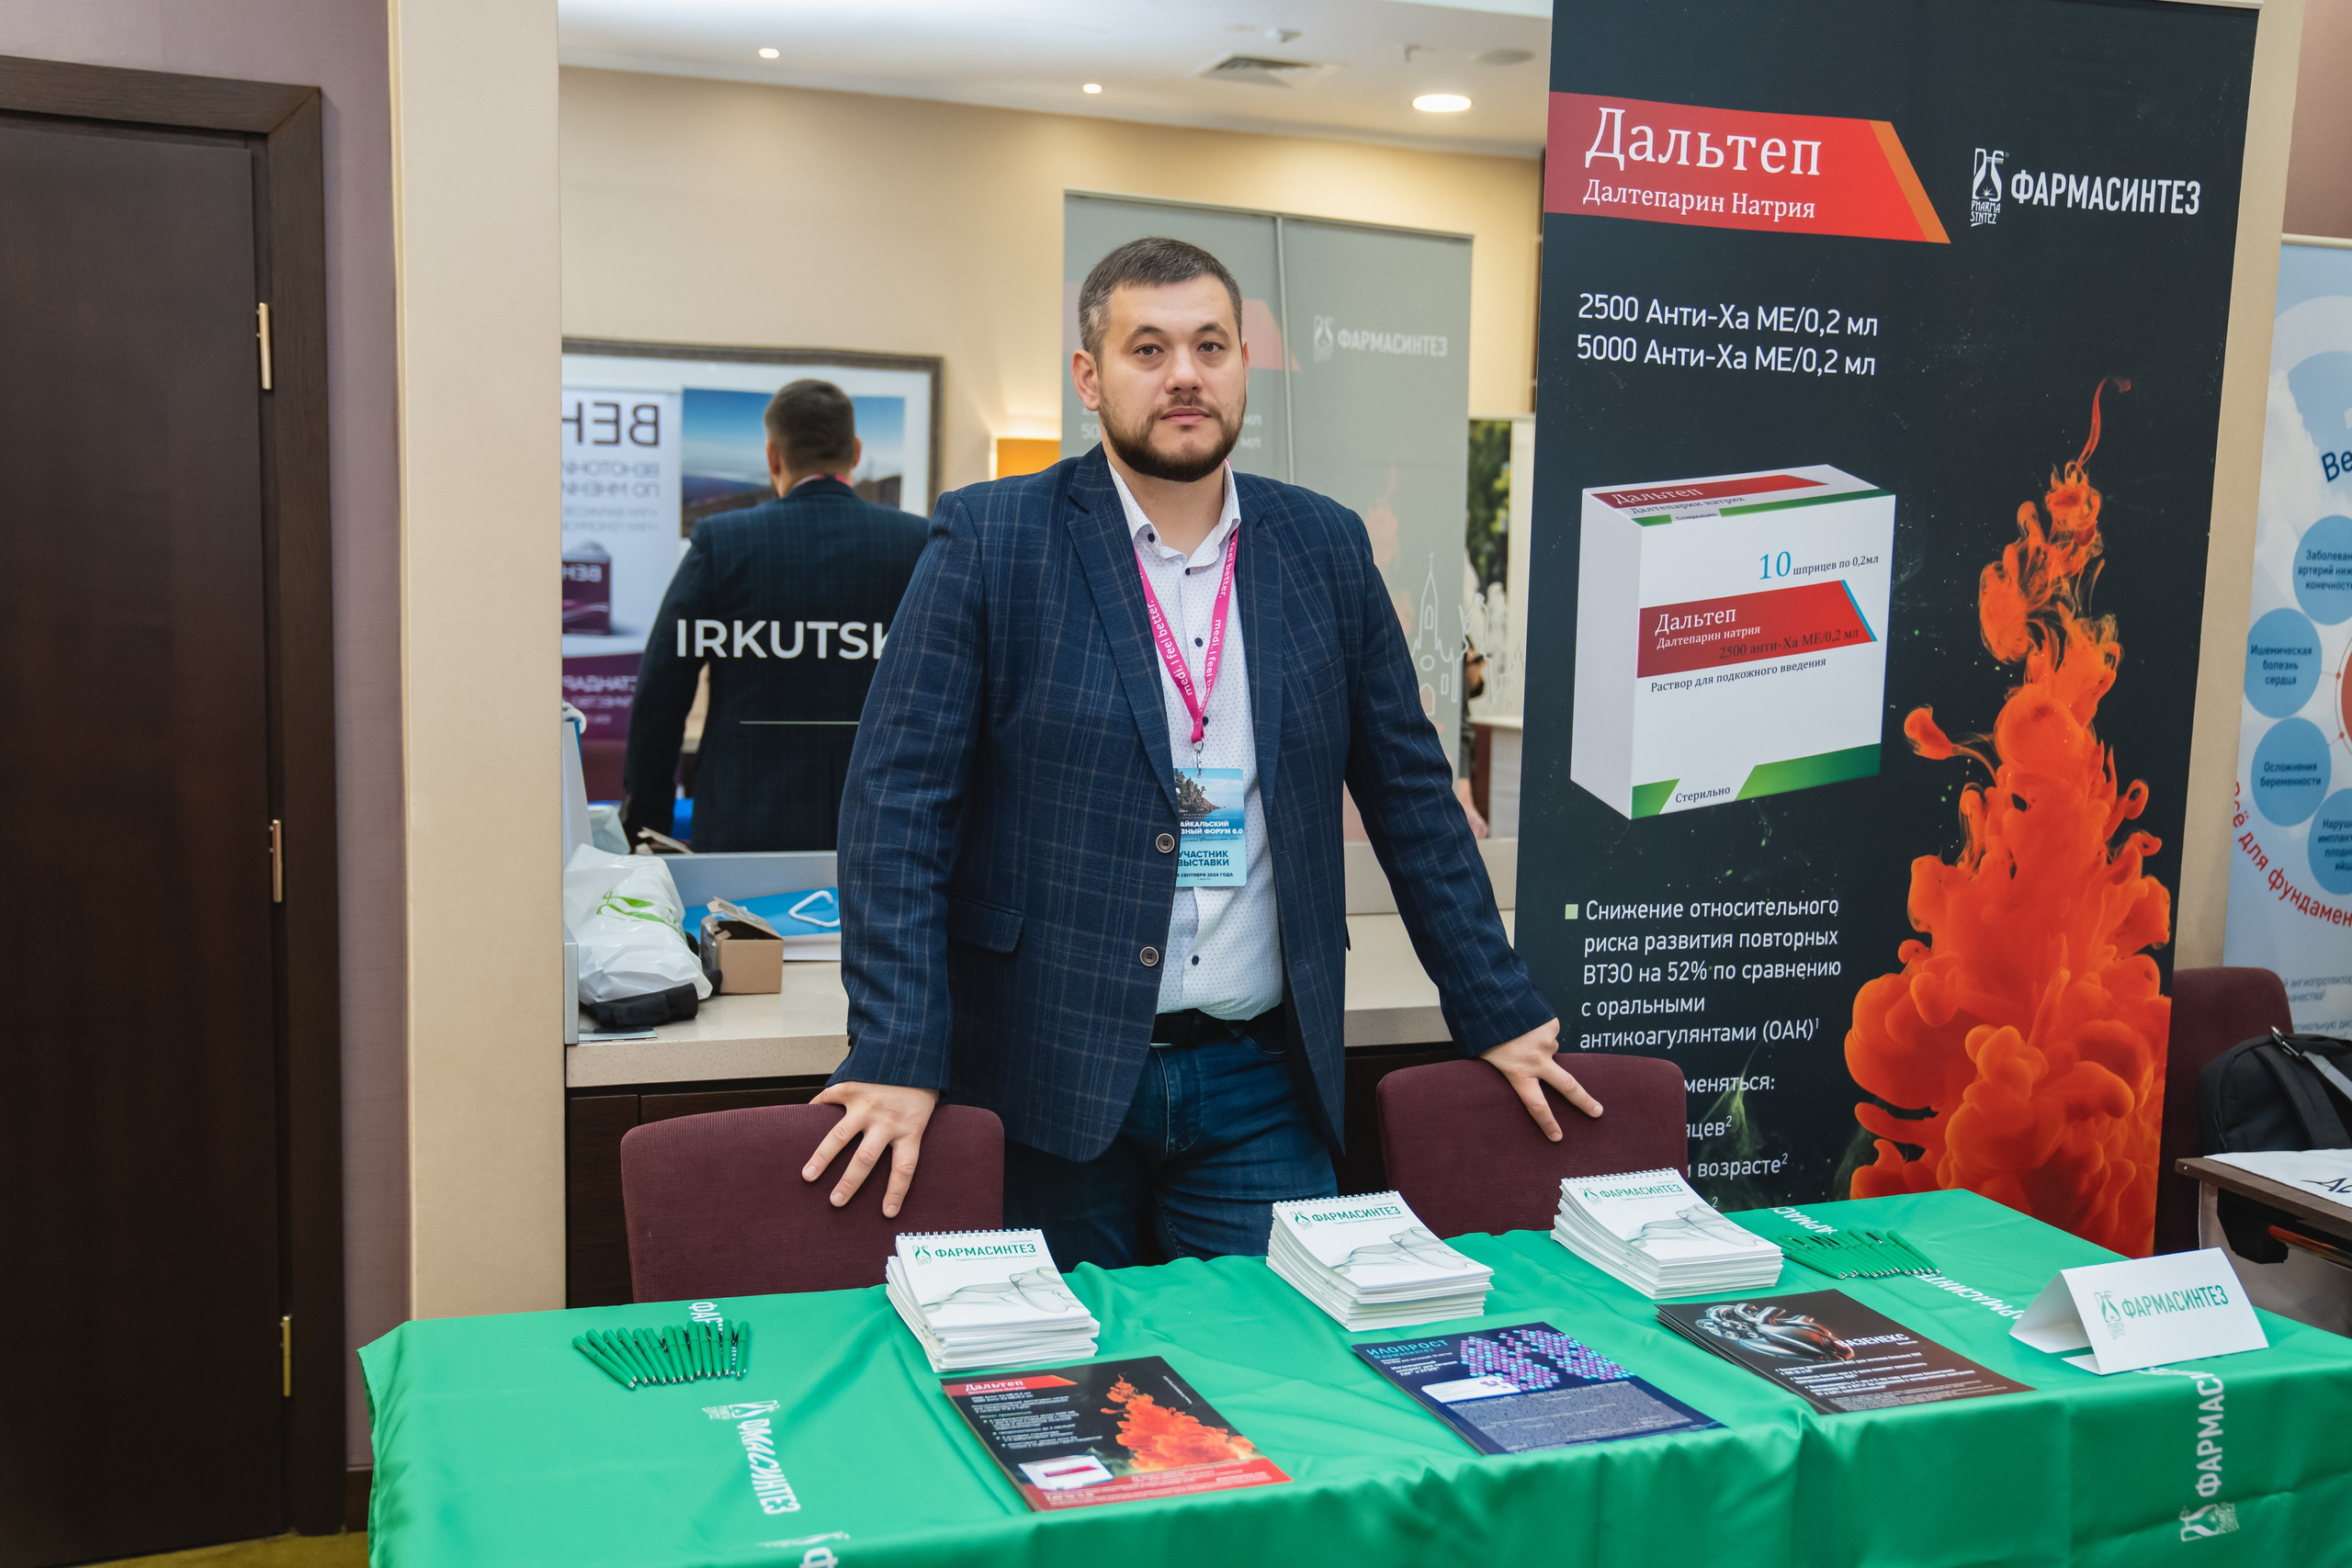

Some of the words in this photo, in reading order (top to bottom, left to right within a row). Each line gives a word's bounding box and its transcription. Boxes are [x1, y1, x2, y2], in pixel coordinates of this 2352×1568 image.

[1585, 107, 1822, 176] Дальтеп
[1582, 178, 1726, 218] Далтепарин
[1731, 193, 1816, 220] Натрия
[2010, 169, 2201, 216] ФАРМАСИНТЕЗ
[1971, 200, 2001, 214] PHARMA
[1577, 292, 1639, 322] 2500
[1645, 298, 1749, 331] Анти-Ха
[1757, 305, 1841, 337] МЕ/0,2
[1847, 316, 1878, 336] мл
[1338, 332, 1447, 357] ФАРМАСИНТЕЗ
[1577, 333, 1637, 364] 5000
[1644, 339, 1747, 370] Анти-Ха
[1755, 346, 1838, 378] МЕ/0,2
[1844, 356, 1875, 376] мл
[1613, 488, 1703, 506] Дальтеп
[1631, 500, 1702, 515] Далтепарин
[1703, 496, 1746, 511] натрия
[1758, 551, 1792, 580] 10
[1793, 561, 1837, 576] шприцев
[1839, 560, 1850, 570] по
[2298, 565, 2334, 578] артерий
[1147, 600, 1168, 638] better.
[1655, 607, 1736, 636] Дальтеп
[1210, 619, 1222, 649] medi.
[1657, 631, 1721, 649] Далтепарин
[1724, 626, 1760, 640] натрия
[1719, 645, 1747, 660] 2500
[1750, 638, 1798, 655] анти-Ха
[1802, 631, 1841, 649] МЕ/0,2
[1844, 628, 1859, 639] мл
[1161, 637, 1178, 660] feel
[2250, 645, 2312, 657] Ишемическая
[1205, 655, 1216, 677] feel
[1651, 677, 1692, 694] Раствор
[1694, 676, 1713, 688] для
[1716, 665, 1778, 683] подкожного
[1781, 659, 1826, 673] введения
[2263, 660, 2299, 671] болезнь
[1173, 665, 1193, 696] medi.
[2265, 676, 2297, 687] сердца
[2264, 761, 2318, 773] Осложнения
[2260, 776, 2322, 788] беременности
[1675, 785, 1731, 804] Стерильно
[2323, 818, 2352, 831] Наруш
[2238, 831, 2268, 872] для
[1587, 900, 1683, 920] Снижение
[1690, 899, 1838, 918] относительного
[1584, 935, 1638, 957] риска
[1645, 932, 1733, 955] развития
[1739, 930, 1838, 952] повторных
[1584, 964, 1633, 985] ВТЭО
[1639, 967, 1661, 982] на
[1668, 961, 1707, 982] 52%
[1713, 965, 1736, 979] по
[1742, 960, 1841, 984] сравнению
[1581, 1002, 1591, 1017] с
[1597, 996, 1705, 1020] оральными
[1580, 1024, 1757, 1049] антикоагулянтами
[1684, 1075, 1775, 1094] меняться:
[1600, 1184, 1683, 1199] ФАРМАСИНТЕЗ
[1312, 1206, 1401, 1223] ФАРМАСИНТЕЗ
[935, 1244, 1036, 1258] ФАРМАСИНТЕЗ
[2121, 1284, 2229, 1319] ФАРМАСИНТЕЗ
[1365, 1339, 1449, 1356] ИЛОПРОСТ
[1836, 1334, 1909, 1348] ВАЗЕНЕКС
[965, 1380, 1024, 1393] Дальтеп
